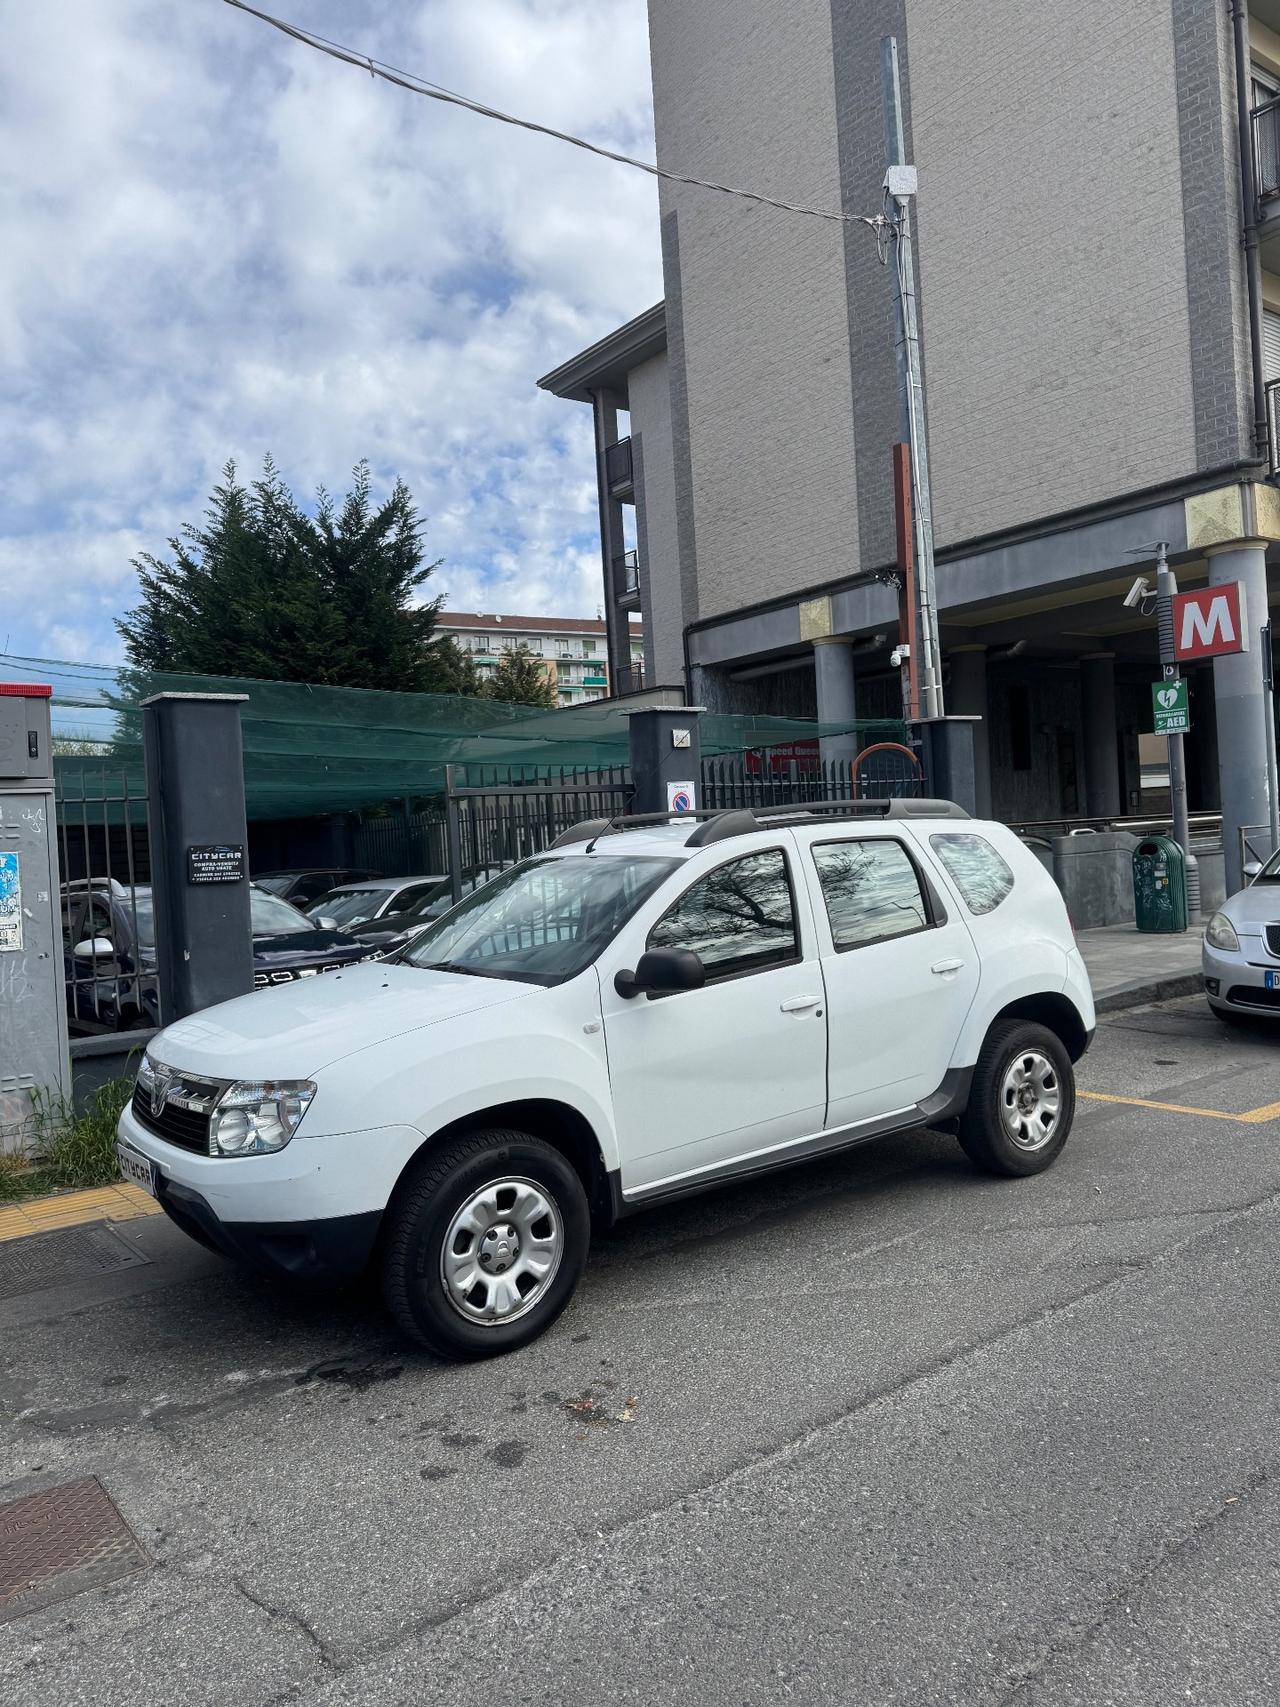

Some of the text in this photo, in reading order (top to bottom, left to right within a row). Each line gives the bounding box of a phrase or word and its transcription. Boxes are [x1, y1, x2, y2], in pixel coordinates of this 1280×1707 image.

[1180, 595, 1236, 650] M
[1167, 716, 1185, 727] AED
[119, 1153, 152, 1186] CITYCAR
